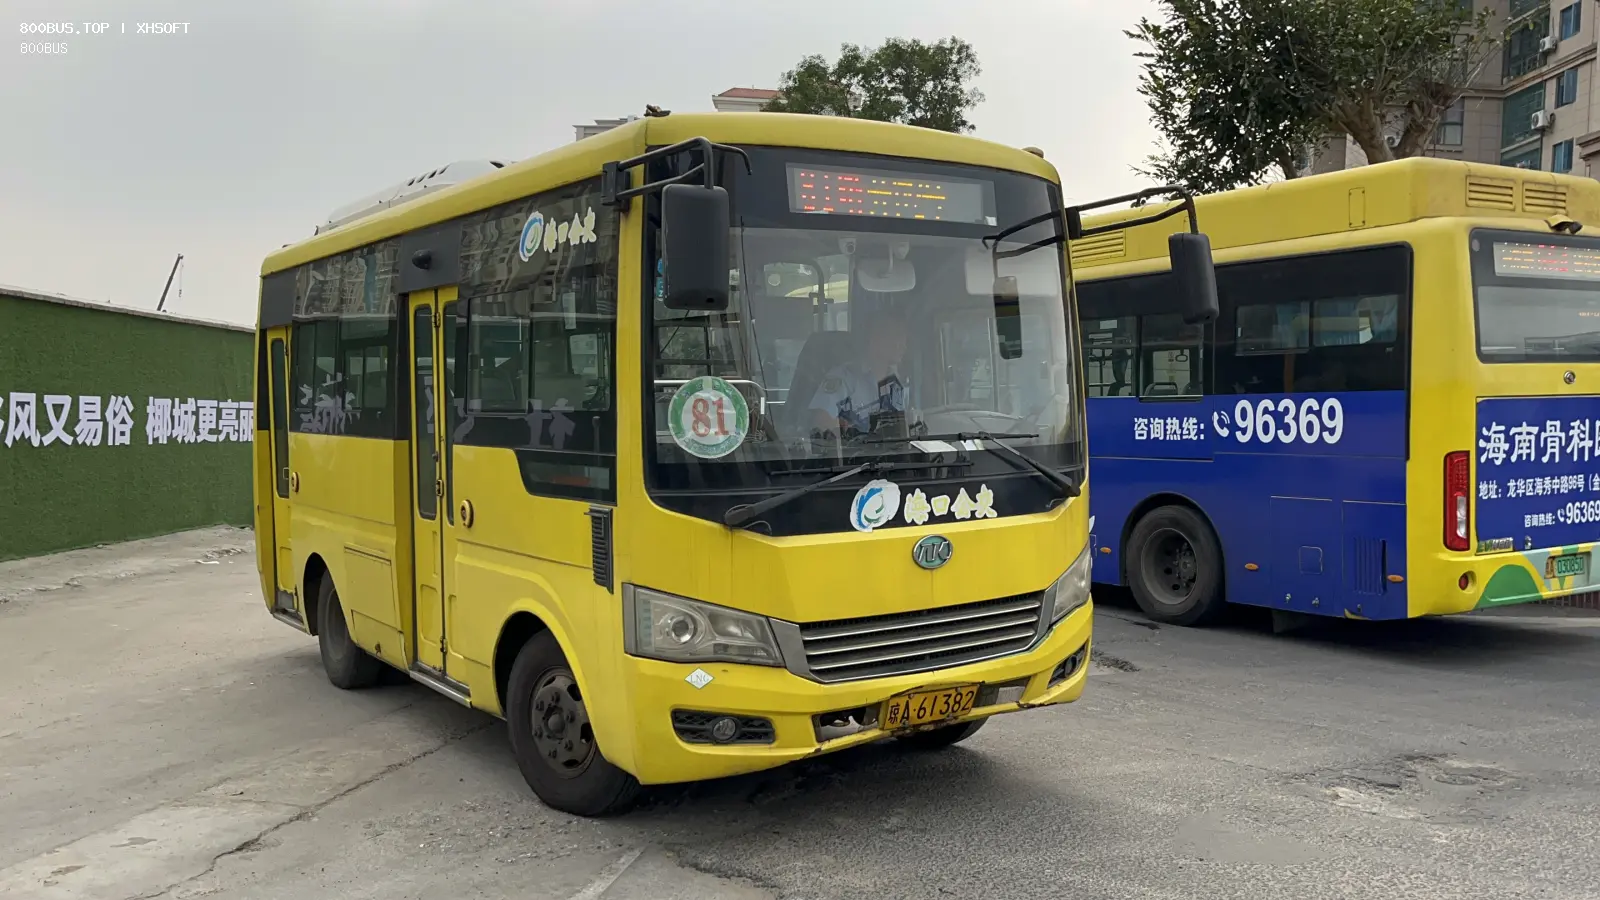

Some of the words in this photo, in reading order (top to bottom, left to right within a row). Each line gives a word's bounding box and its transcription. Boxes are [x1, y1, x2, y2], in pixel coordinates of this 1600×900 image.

[0, 391, 134, 448] 风又易俗
[691, 396, 730, 438] 81
[1133, 416, 1205, 441] 咨询热线：
[1234, 397, 1344, 445] 96369
[1478, 418, 1600, 465] 海南骨科
[1565, 502, 1600, 524] 96369
